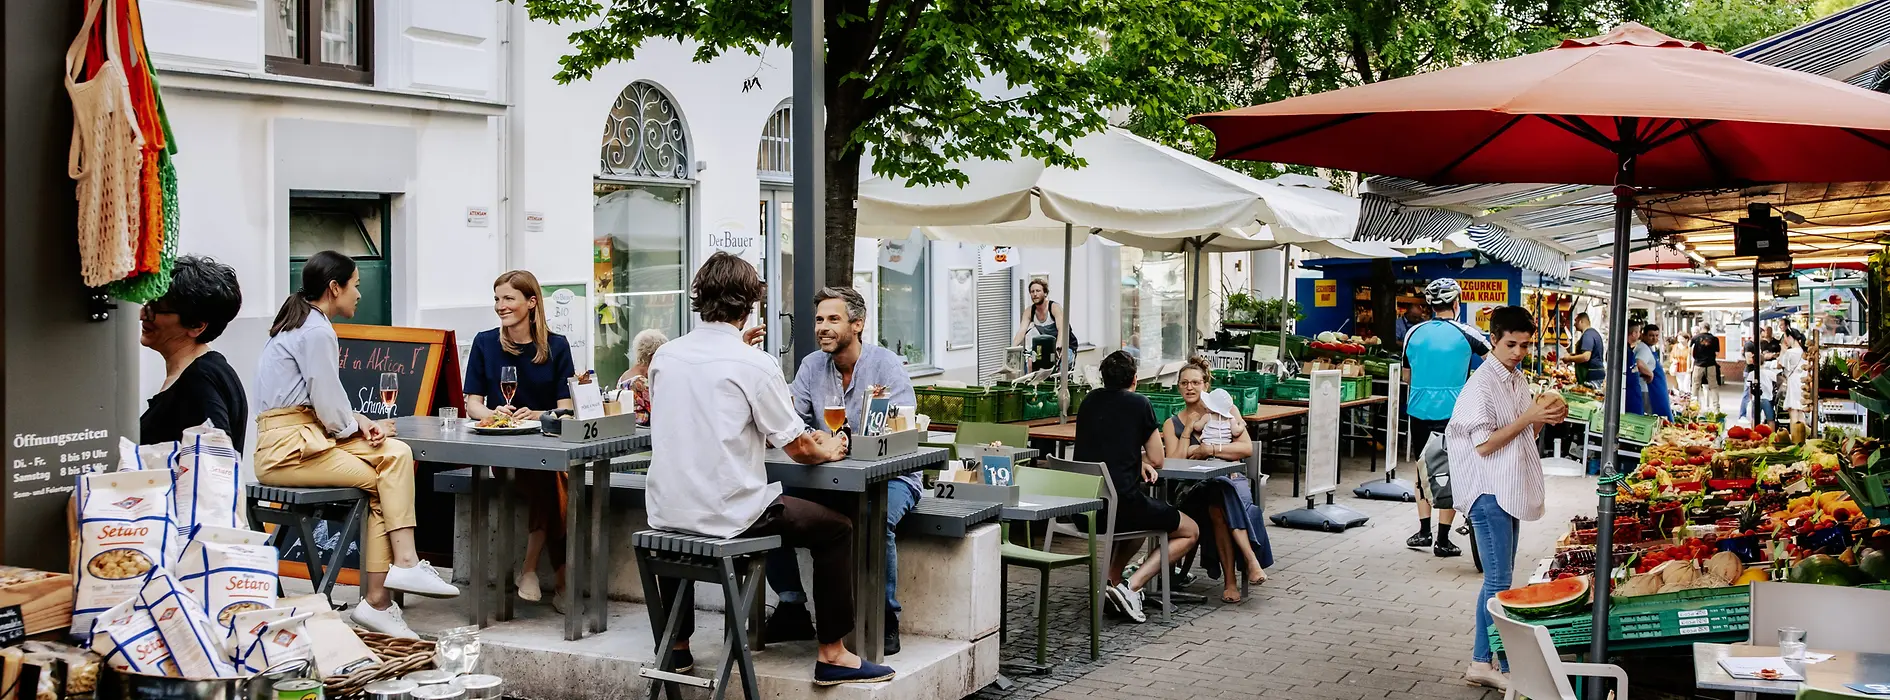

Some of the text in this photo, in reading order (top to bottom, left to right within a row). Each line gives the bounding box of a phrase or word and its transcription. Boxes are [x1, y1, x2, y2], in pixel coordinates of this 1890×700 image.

[1478, 292, 1506, 302] KRAUT
[352, 356, 362, 370] in
[13, 428, 108, 448] Öffnungszeiten
[583, 421, 598, 440] 26
[877, 437, 888, 457] 21
[13, 459, 27, 469] Di.
[34, 456, 47, 467] Fr.
[60, 454, 67, 463] 8
[67, 452, 81, 462] bis
[81, 450, 92, 460] 19
[92, 449, 109, 459] Uhr
[13, 470, 51, 483] Samstag
[60, 467, 67, 476] 8
[67, 465, 81, 475] bis
[81, 463, 92, 473] 15
[13, 491, 32, 499] Sonn-
[32, 487, 45, 496] und
[45, 484, 74, 495] Feiertage
[935, 483, 955, 499] 22
[97, 525, 149, 540] Setaro
[225, 575, 270, 591] Setaro
